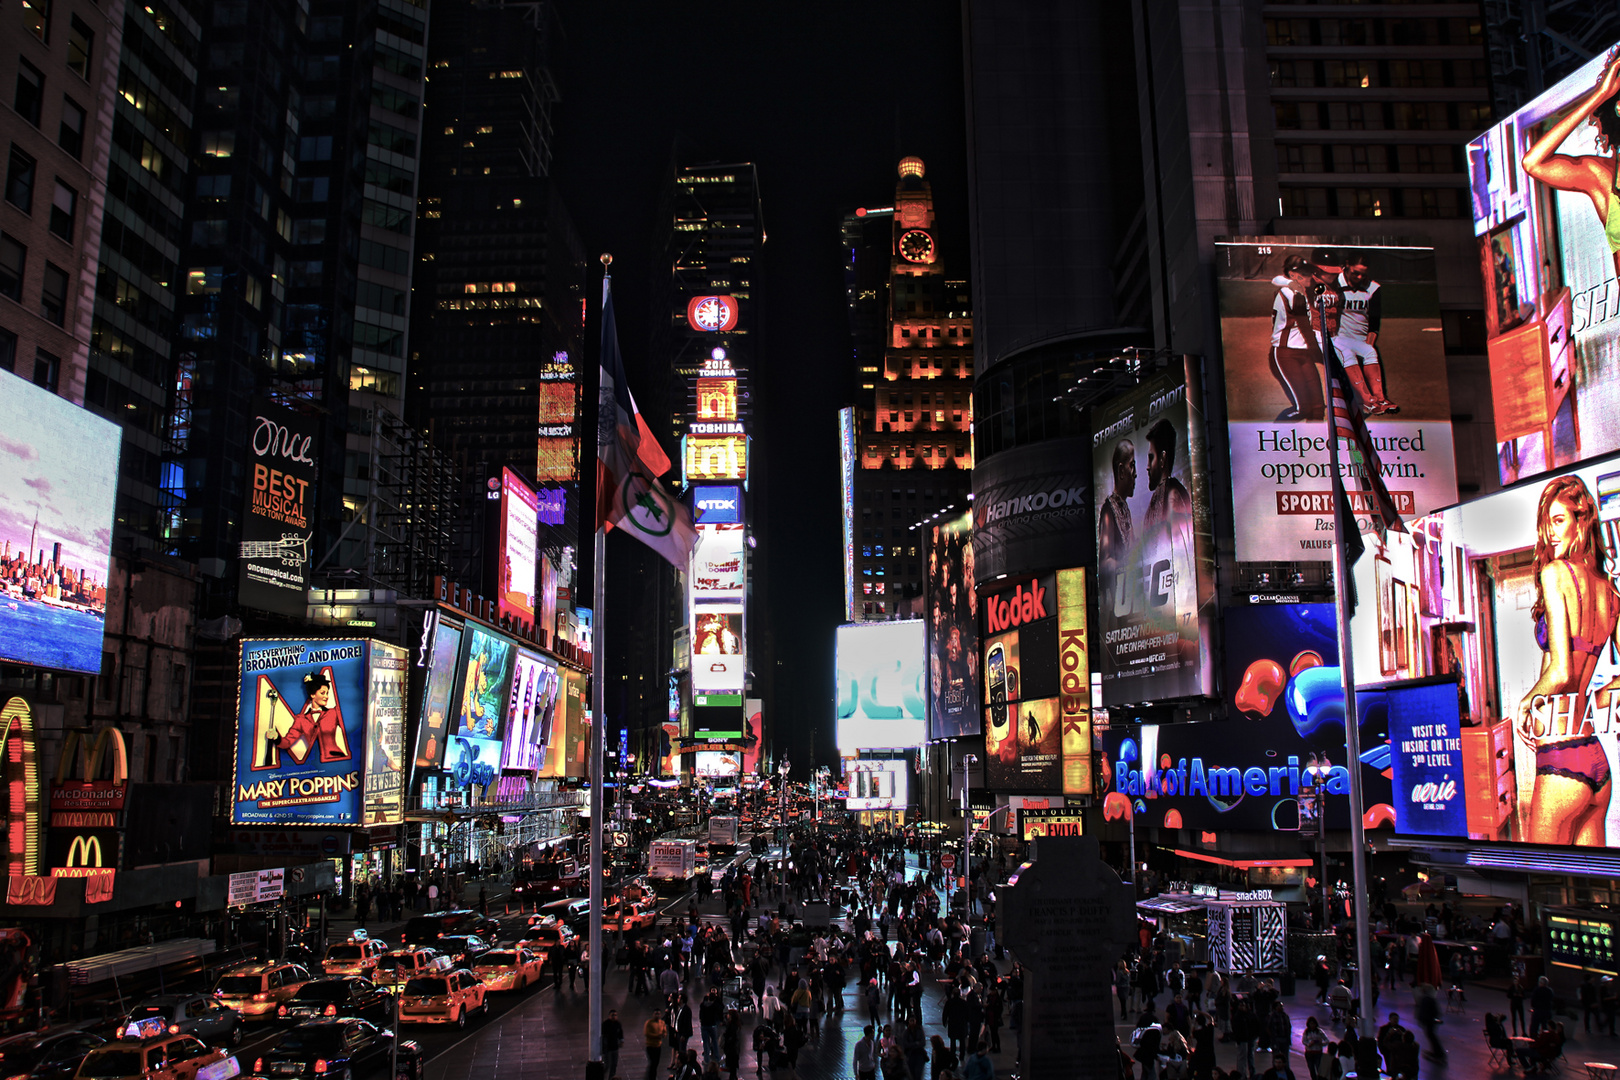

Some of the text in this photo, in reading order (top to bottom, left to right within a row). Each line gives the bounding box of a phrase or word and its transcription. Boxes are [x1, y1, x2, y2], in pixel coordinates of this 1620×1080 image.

[699, 369, 736, 377] TOSHIBA
[705, 360, 731, 370] 2012
[1149, 383, 1185, 418] CONDIT
[689, 422, 744, 434] TOSHIBA
[253, 463, 309, 505] BEST
[487, 491, 500, 499] LG
[252, 489, 307, 521] MUSICAL
[707, 499, 736, 510] TDK
[251, 505, 307, 529] 2012 TONY AWARD
[998, 507, 1085, 530] driving emotion
[1314, 518, 1335, 531] Pas
[247, 563, 304, 584] oncemusical.com
[697, 577, 720, 585] HOT
[1113, 558, 1171, 618] UFC
[435, 575, 548, 648] BERTELSMANN
[987, 578, 1047, 634] Kodak
[1105, 624, 1141, 644] SATURDAY
[249, 645, 305, 660] IT'S EVERYTHING
[308, 650, 329, 664] AND
[330, 646, 362, 661] MORE!
[1116, 643, 1129, 655] LIVE
[1060, 628, 1088, 737] Kodak
[1412, 724, 1448, 738] VISIT US
[1402, 738, 1461, 753] INSIDE ON THE
[1427, 754, 1452, 766] LEVEL
[365, 772, 401, 792] NEWSIES
[1167, 758, 1187, 796] of
[53, 789, 123, 799] McDonald's
[238, 771, 360, 803] MARY POPPINS
[1411, 774, 1458, 803] aerie
[1048, 823, 1079, 836] EVITA
[655, 846, 681, 855] milea
[1029, 906, 1067, 917] FRANCIS
[1079, 905, 1111, 916] DUFFY
